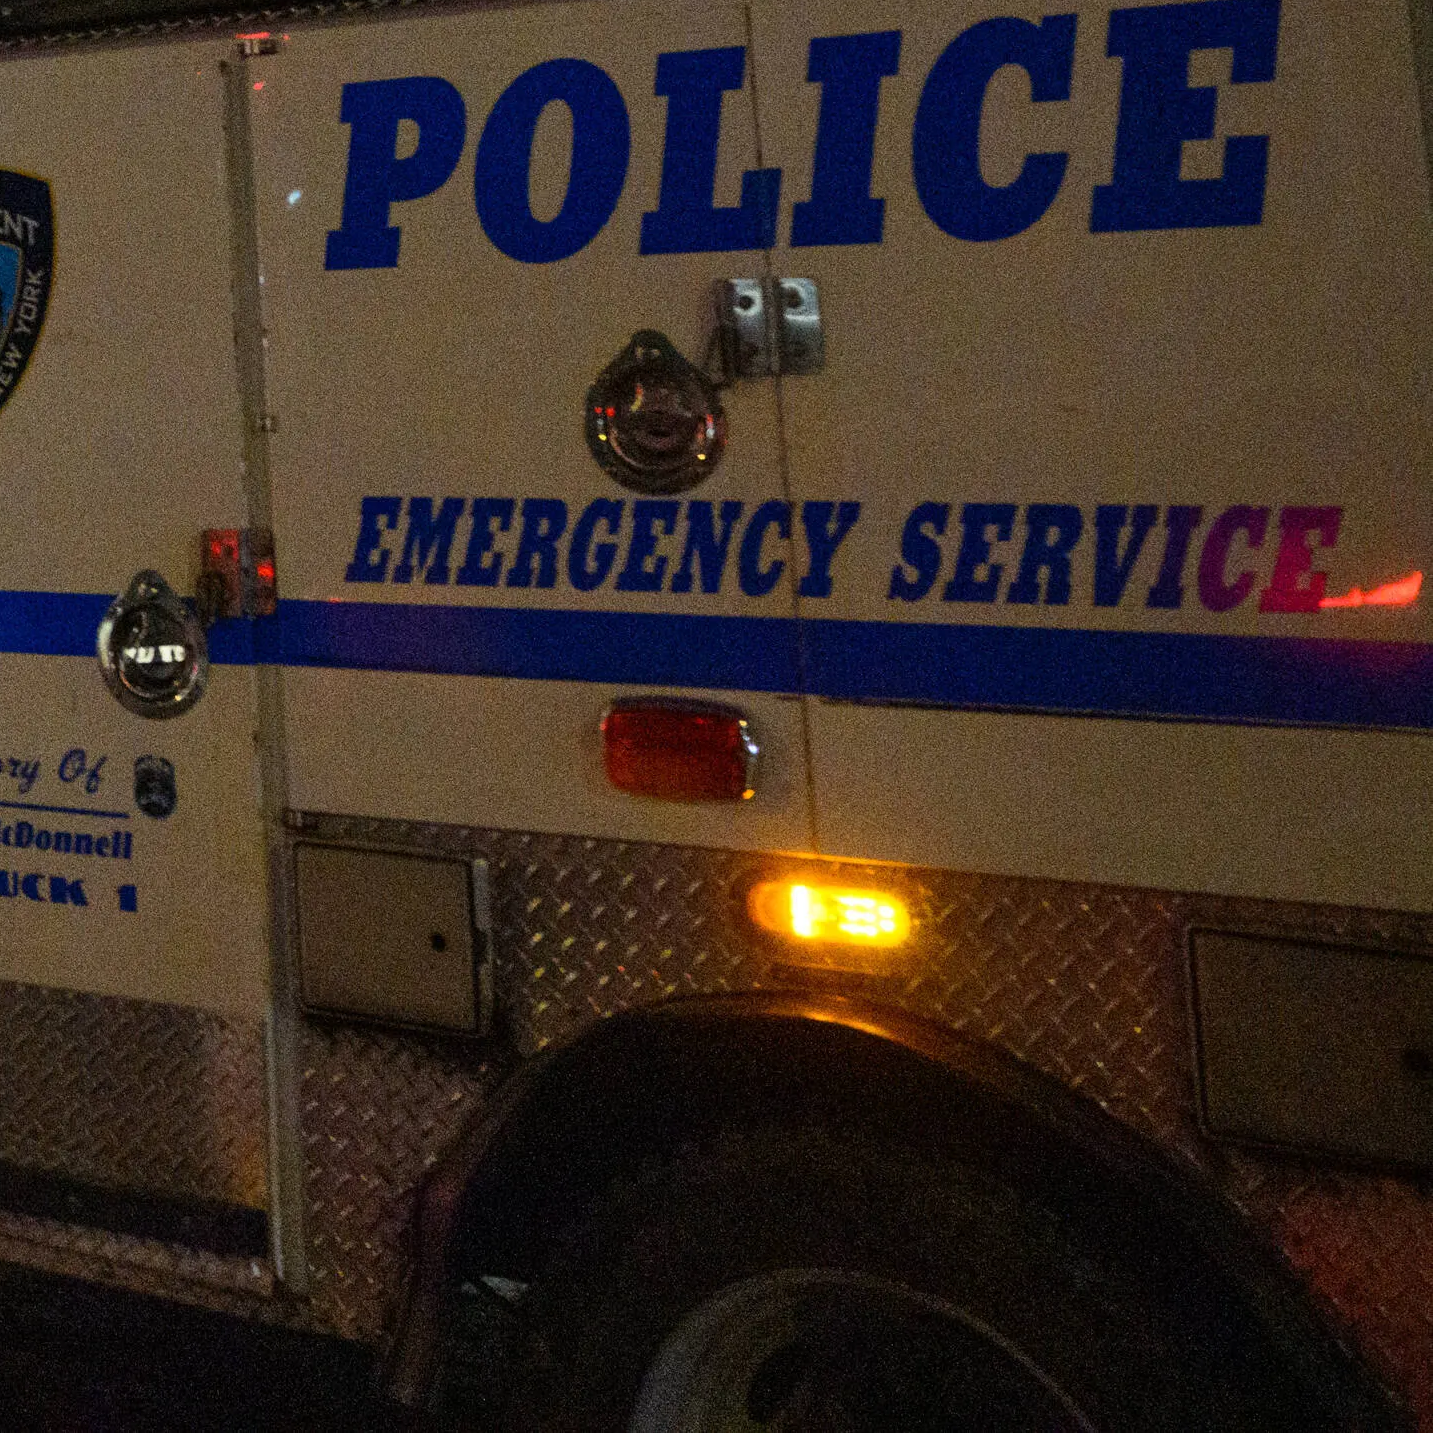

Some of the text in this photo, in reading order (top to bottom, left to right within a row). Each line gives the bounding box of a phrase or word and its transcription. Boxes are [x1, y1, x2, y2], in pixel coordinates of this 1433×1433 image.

[15, 267, 44, 336] YORK
[345, 495, 1344, 613] EMERGENCY SERVICE
[57, 746, 108, 795] Of
[117, 883, 139, 913] 1
